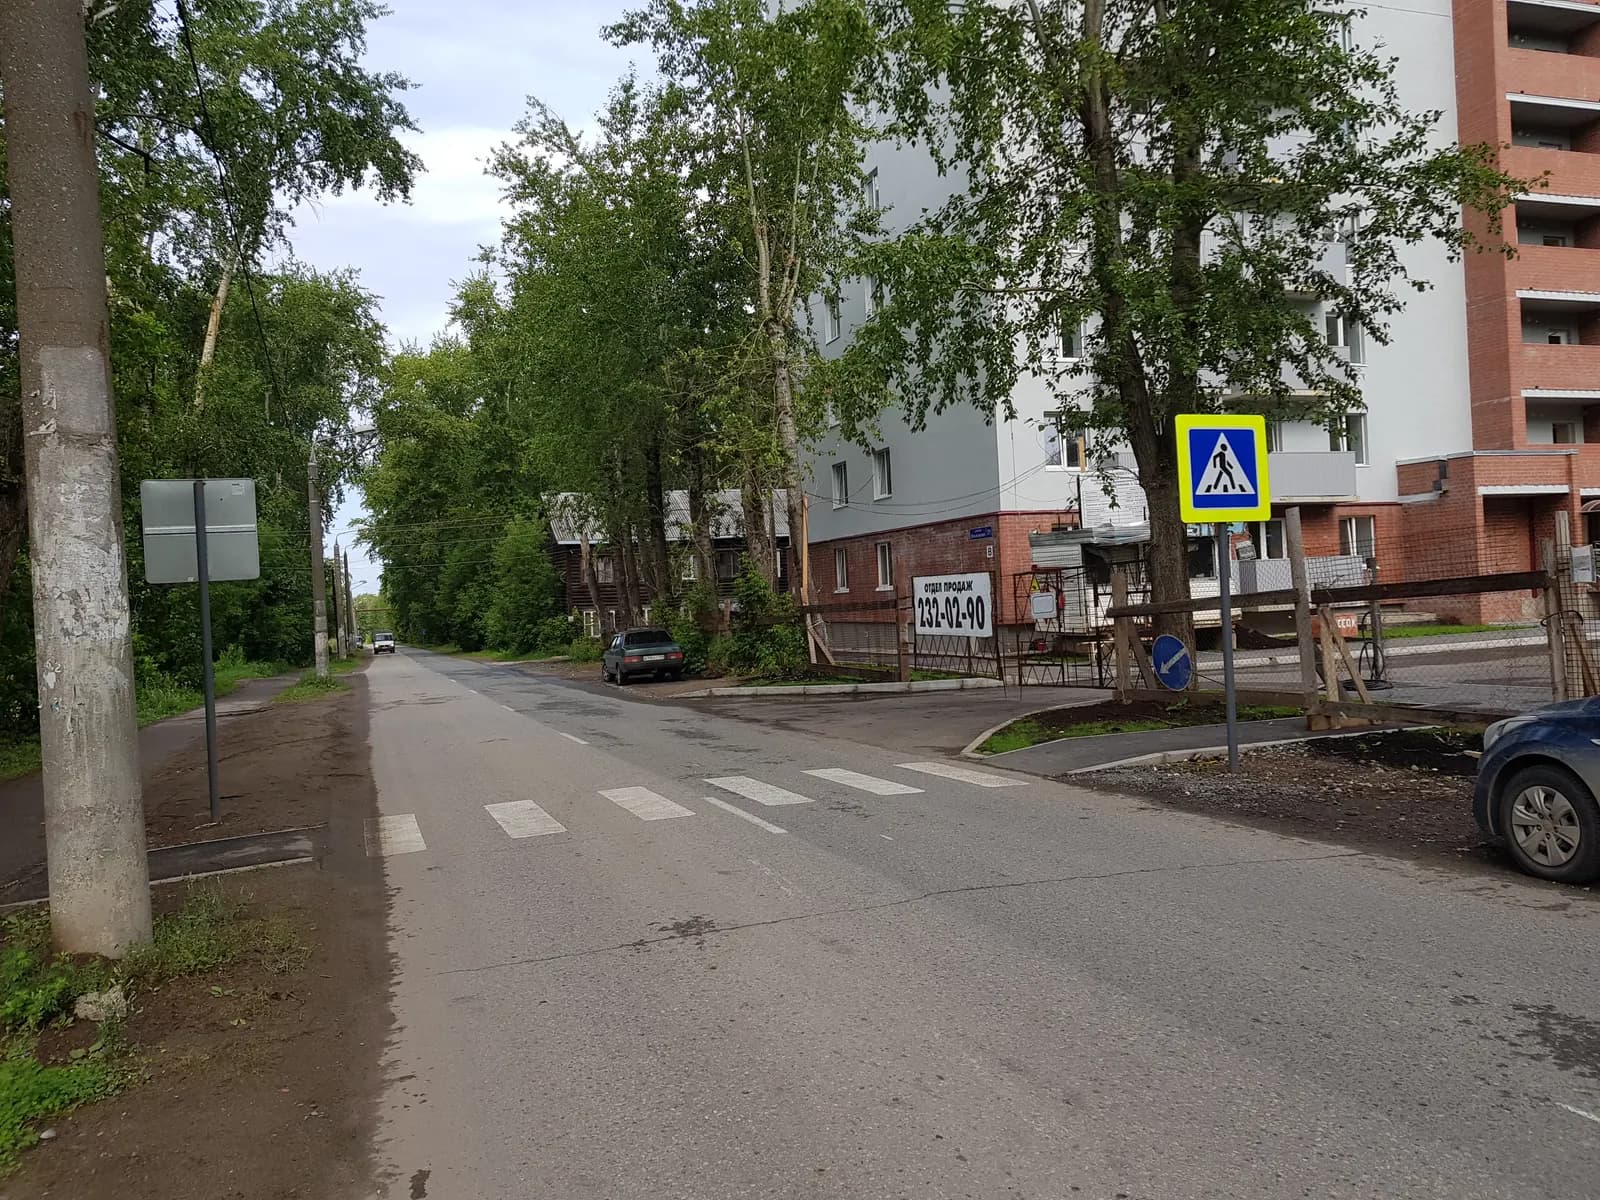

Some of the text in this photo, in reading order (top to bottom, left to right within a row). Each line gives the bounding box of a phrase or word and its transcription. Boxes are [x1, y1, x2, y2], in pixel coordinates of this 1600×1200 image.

[924, 580, 973, 594] ОТДЕЛ ПРОДАЖ
[918, 595, 985, 630] 232-02-90
